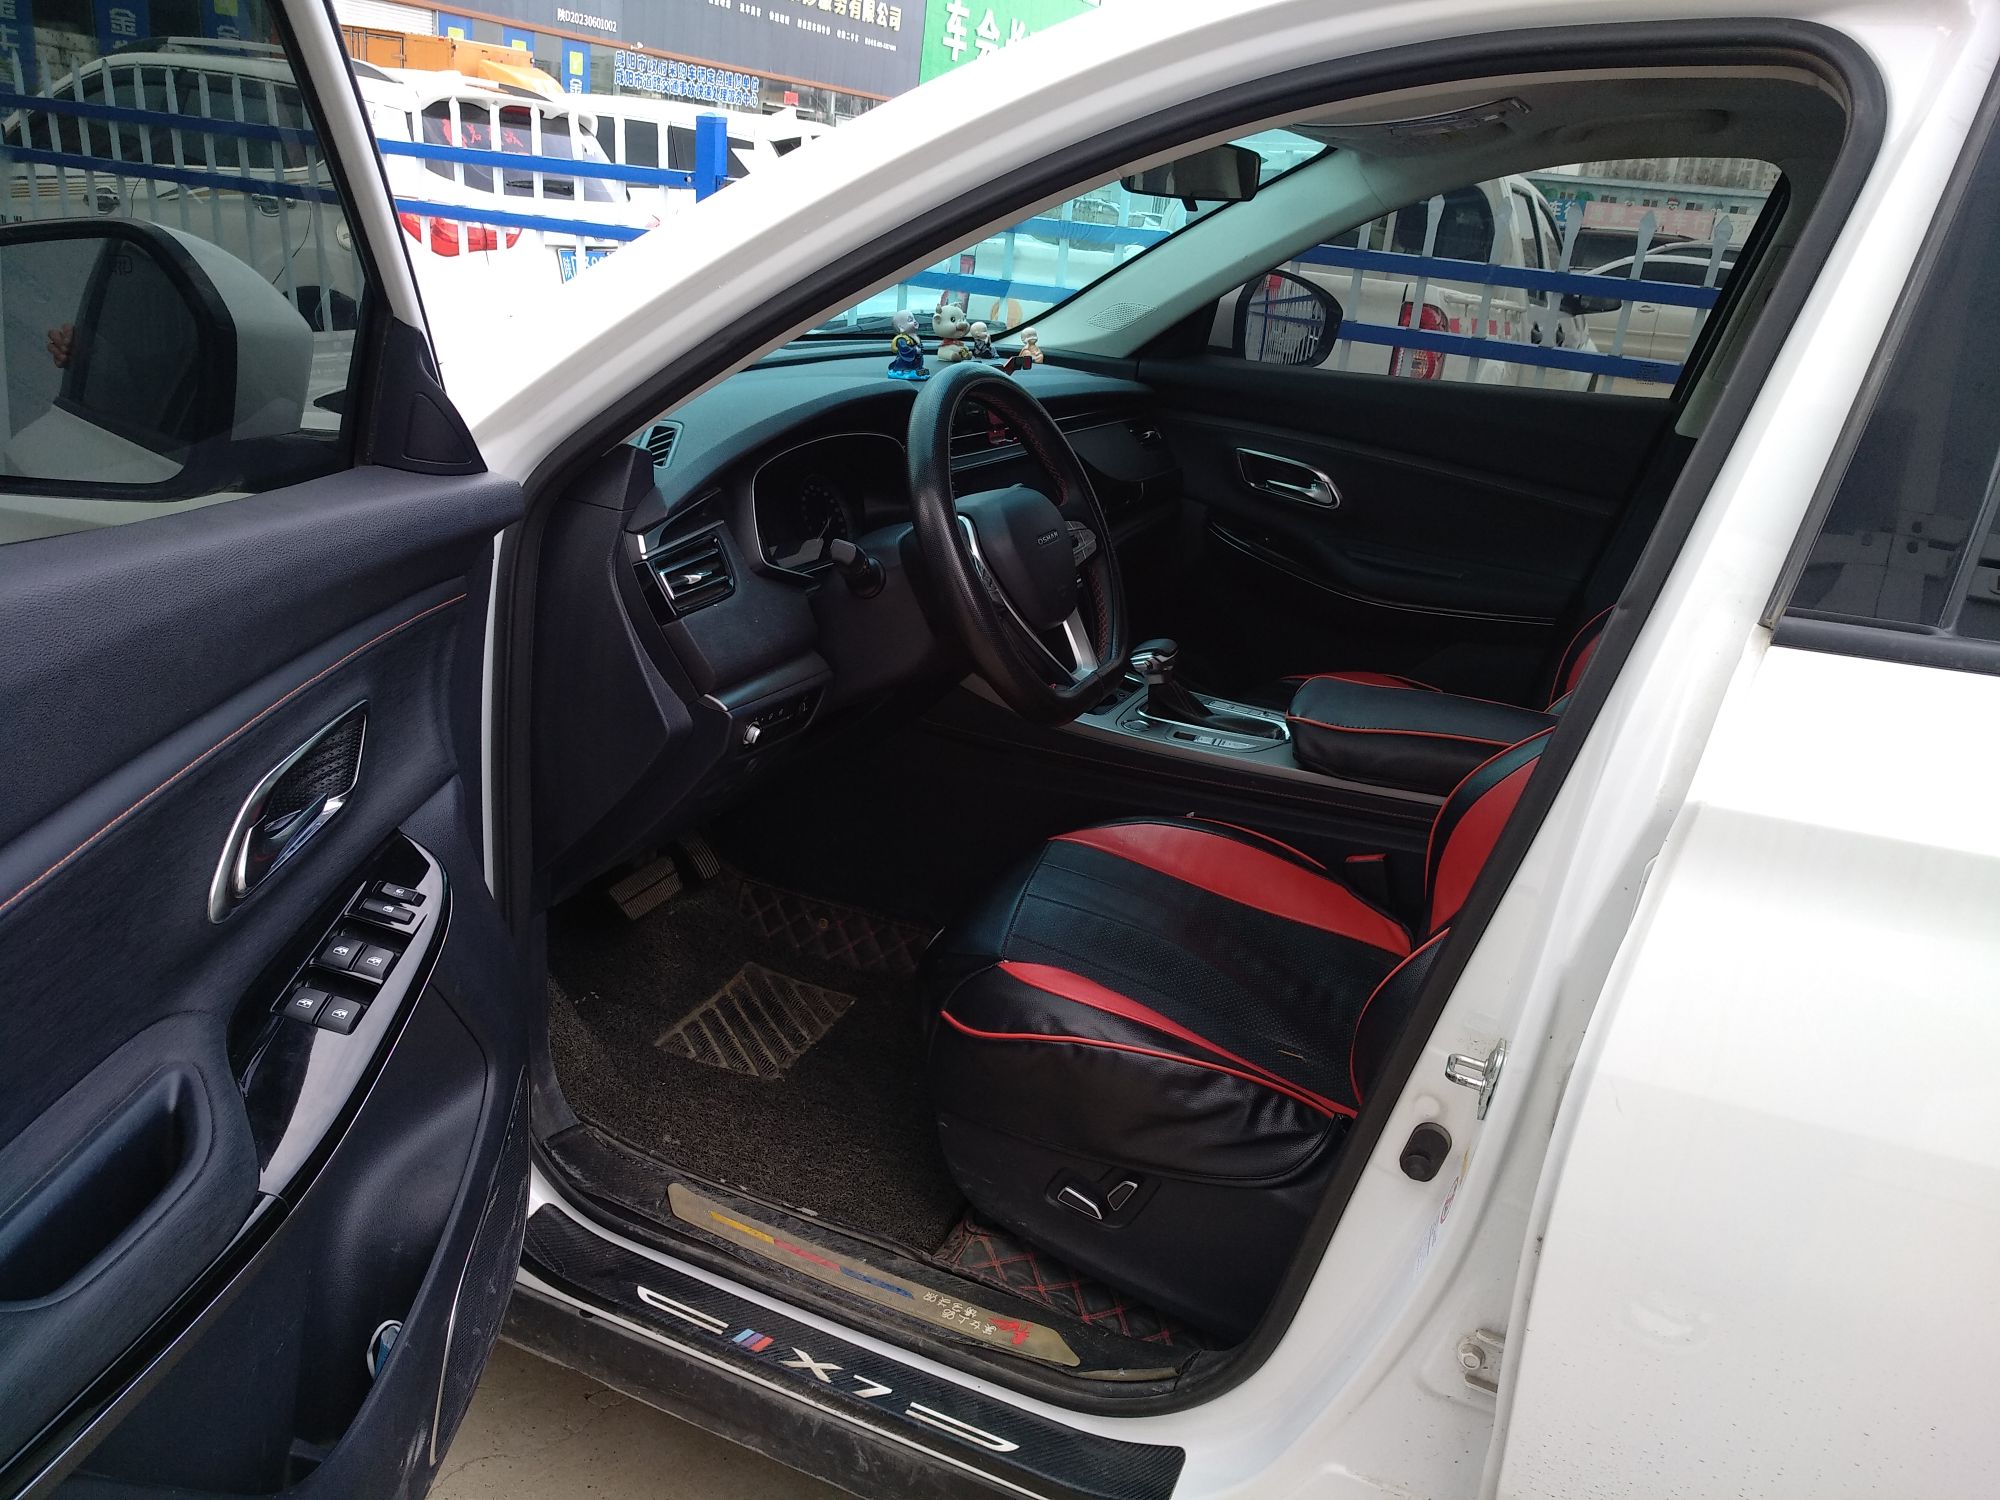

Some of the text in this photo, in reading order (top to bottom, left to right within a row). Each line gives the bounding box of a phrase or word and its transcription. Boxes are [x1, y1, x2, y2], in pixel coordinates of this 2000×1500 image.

[557, 7, 617, 33] 陕D20230601002
[614, 68, 759, 108] 咸阳市道路交通事故快速处理服务中心
